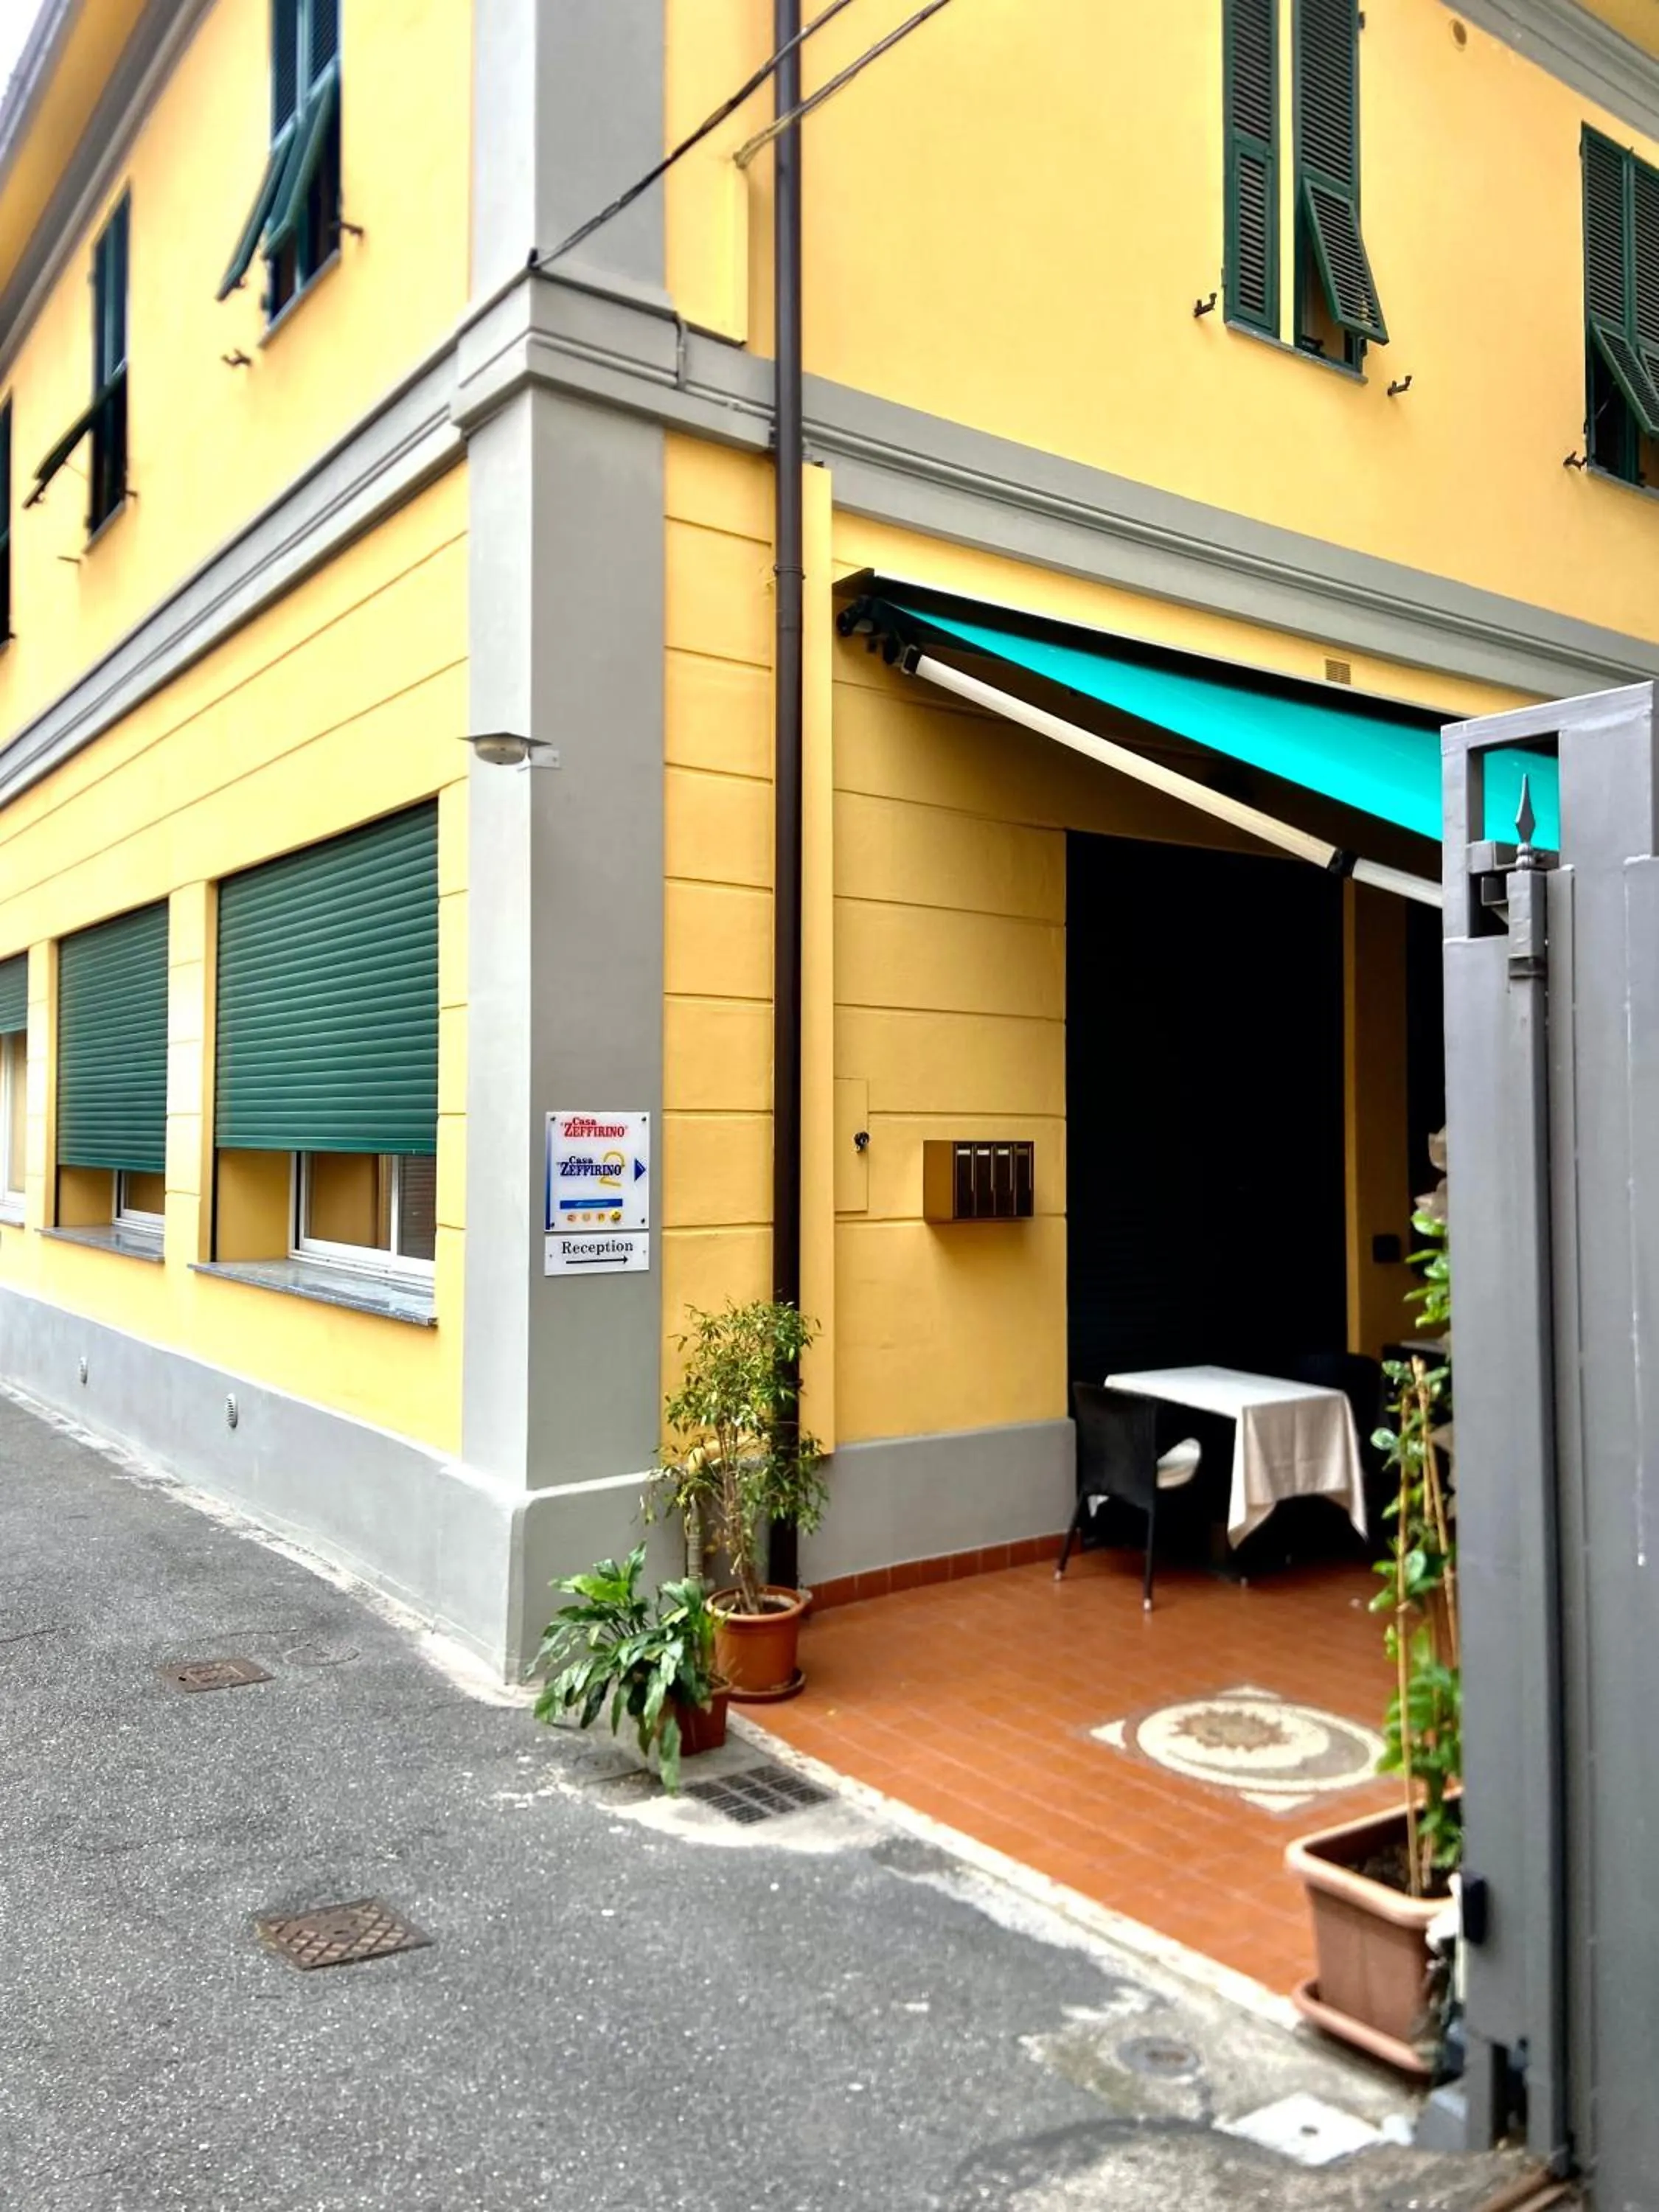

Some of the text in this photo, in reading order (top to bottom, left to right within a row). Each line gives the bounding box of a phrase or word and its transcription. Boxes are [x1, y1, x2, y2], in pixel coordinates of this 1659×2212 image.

[572, 1116, 597, 1126] Casa
[568, 1155, 594, 1164] Casa
[561, 1239, 633, 1256] Reception
